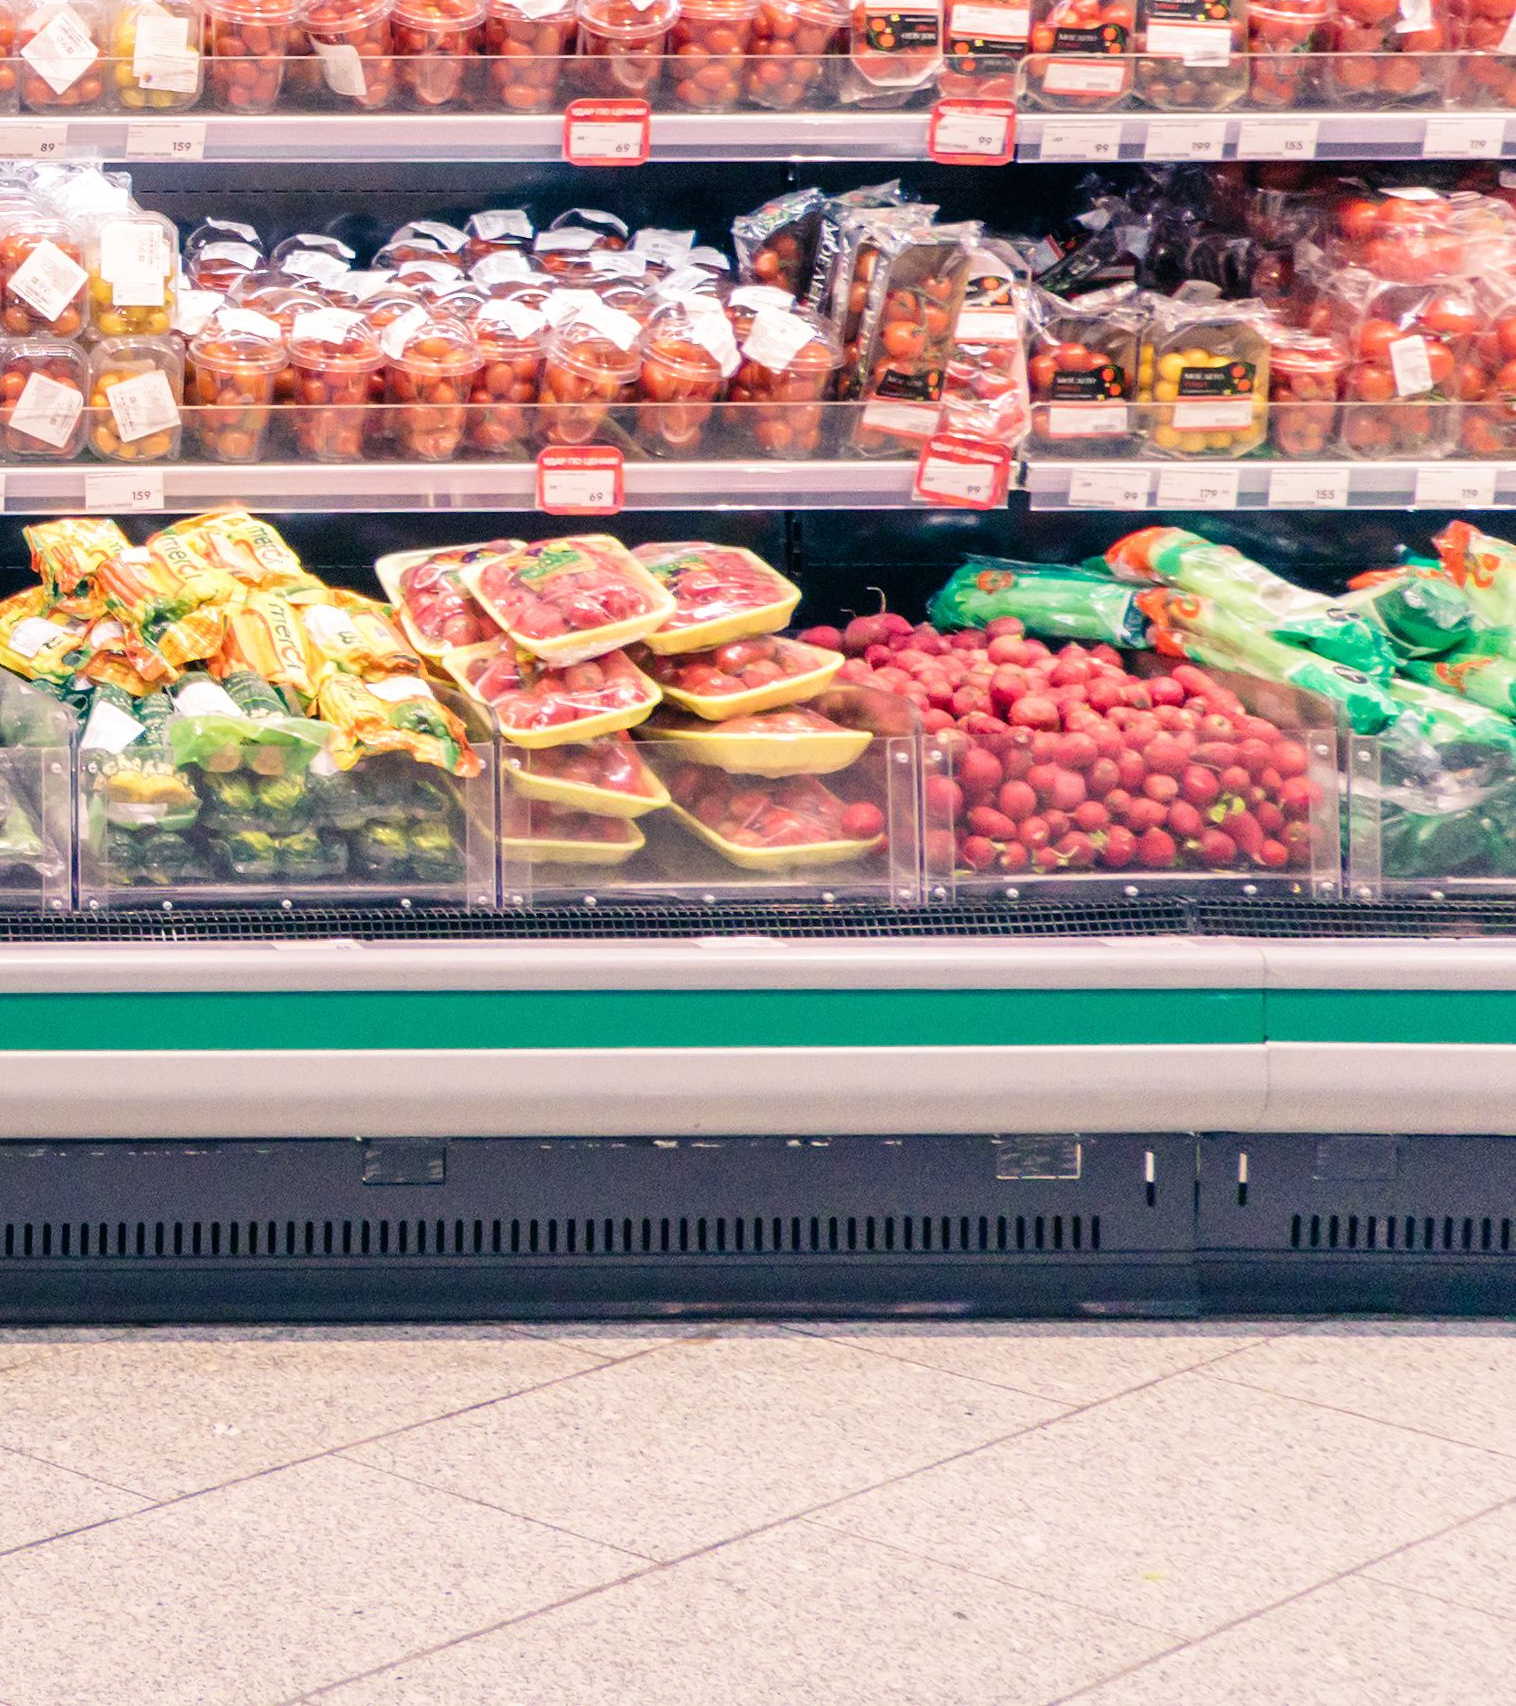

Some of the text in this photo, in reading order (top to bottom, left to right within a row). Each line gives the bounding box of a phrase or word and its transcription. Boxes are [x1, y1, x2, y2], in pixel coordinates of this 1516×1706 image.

[978, 136, 993, 146] 99
[40, 142, 55, 152] 89
[172, 142, 191, 152] 159
[616, 143, 630, 153] 69
[1094, 143, 1110, 153] 99
[966, 484, 982, 495] 99
[131, 491, 152, 501] 159
[589, 492, 603, 502] 69
[1123, 491, 1138, 501] 99
[245, 524, 285, 568] merci
[161, 535, 202, 581] merci
[268, 601, 303, 671] merci
